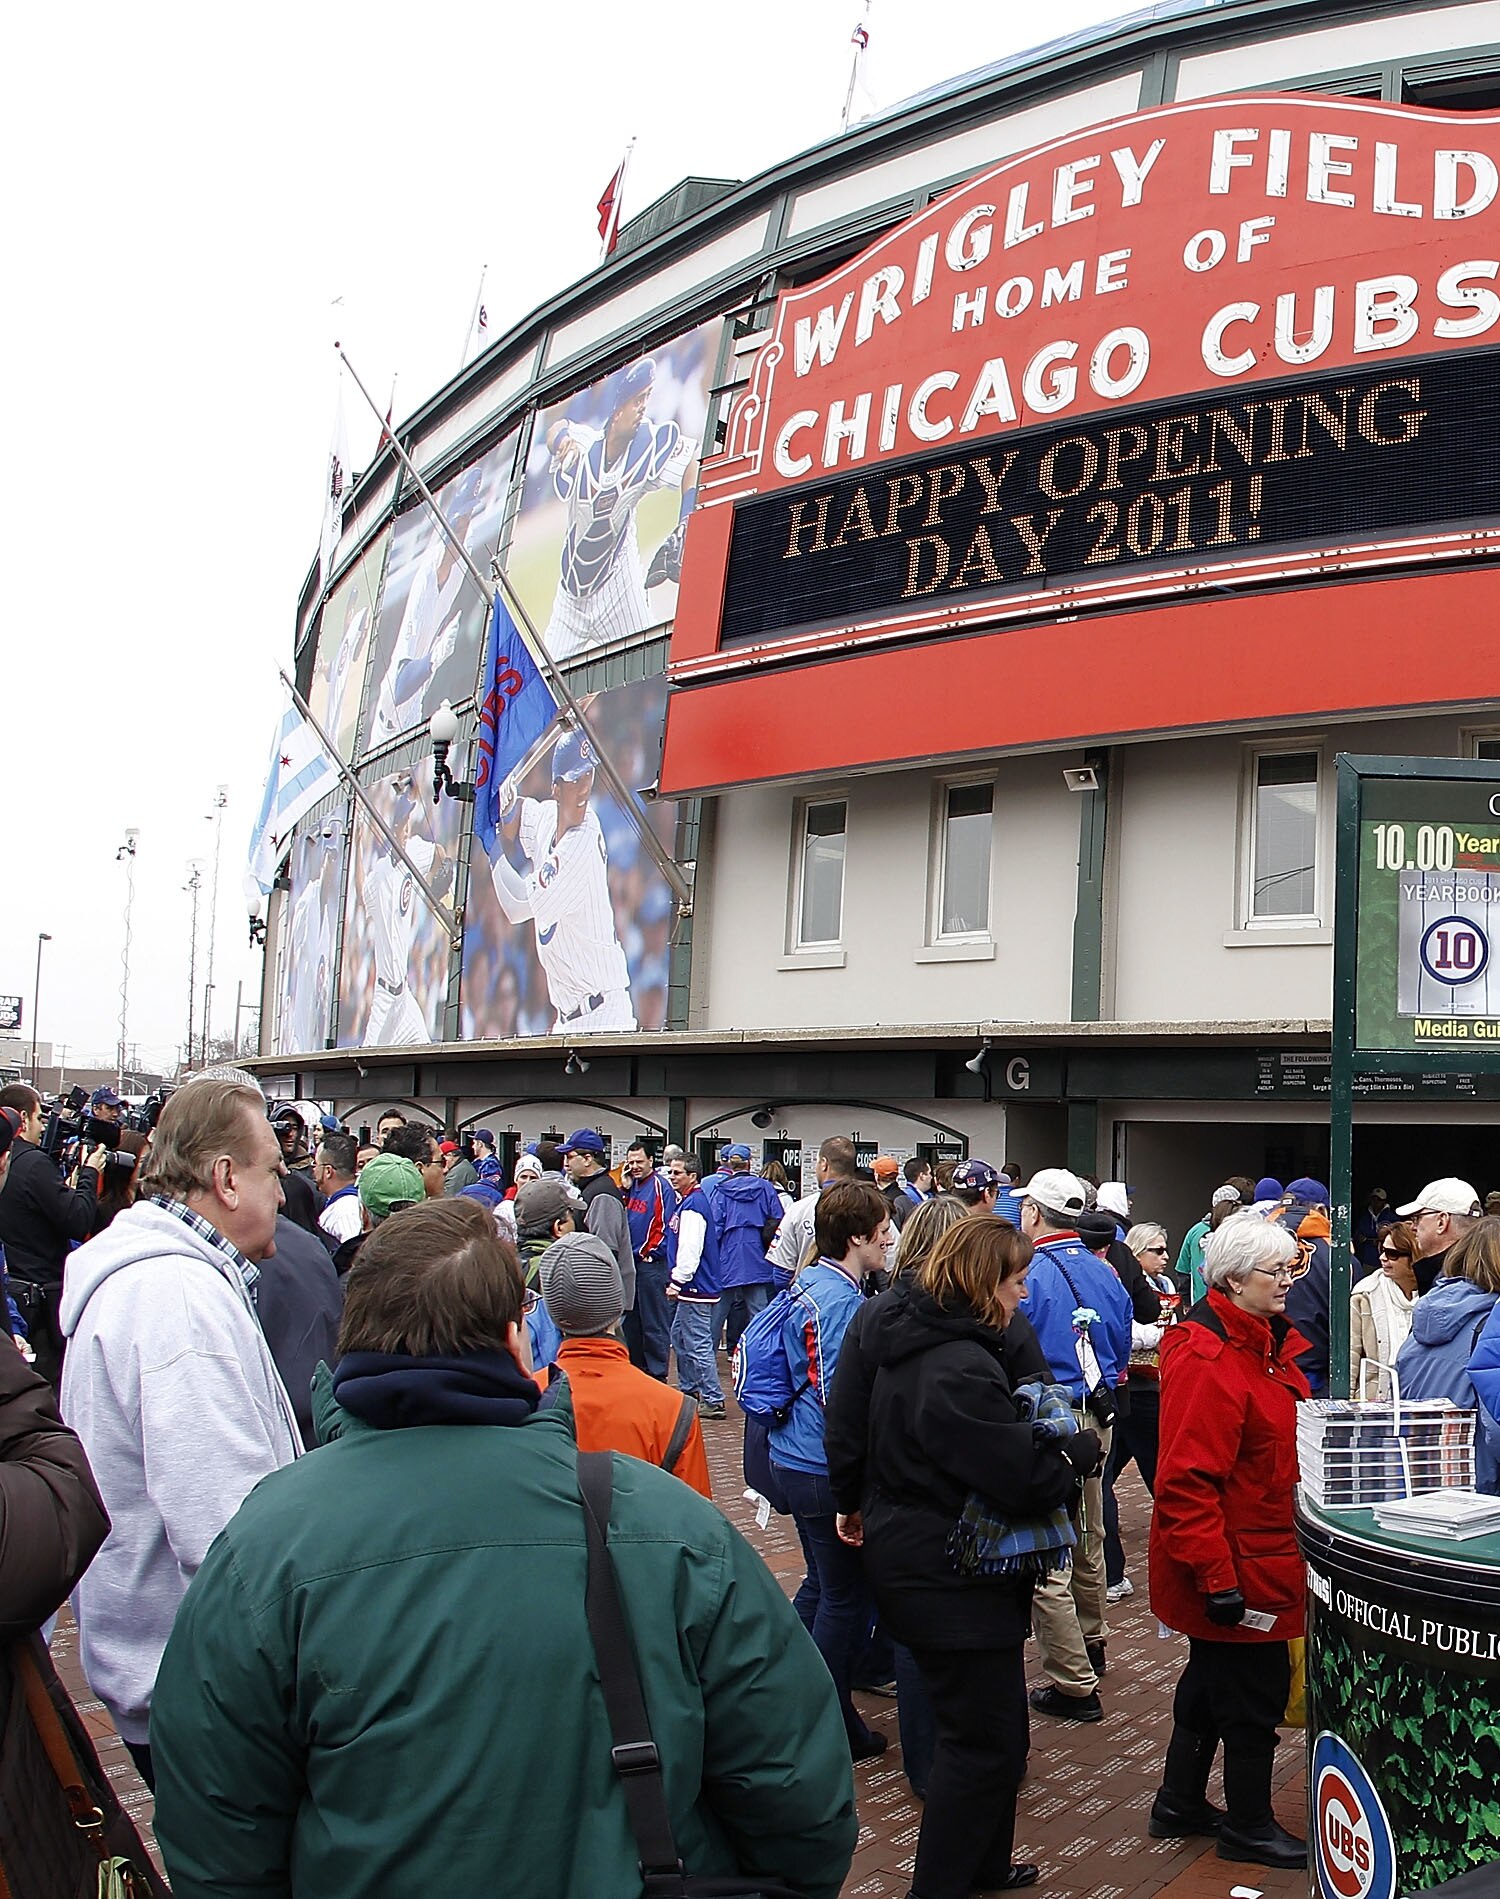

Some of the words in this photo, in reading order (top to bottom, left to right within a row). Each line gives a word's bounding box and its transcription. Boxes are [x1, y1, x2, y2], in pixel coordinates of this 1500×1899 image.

[794, 137, 1167, 378] WRIGLEY
[1208, 127, 1500, 221] FIELD
[952, 248, 1132, 332] HOME
[1183, 214, 1277, 273] OF
[773, 325, 1151, 478] CHICAGO
[1201, 259, 1500, 377] CUBS
[782, 449, 1020, 559] HAPPY
[1037, 377, 1428, 501] OPENING
[900, 508, 1064, 599] DAY
[1083, 473, 1264, 566] 2011!
[1372, 824, 1454, 872] 10.00
[1434, 930, 1477, 970] 10
[1413, 1019, 1468, 1039] Media
[1005, 1056, 1030, 1091] G
[507, 1123, 514, 1131] 17
[709, 1128, 719, 1138] 13
[777, 1129, 788, 1139] 12
[850, 1131, 861, 1142] 11
[933, 1132, 946, 1144] 10
[783, 1149, 800, 1167] OPE
[1336, 1589, 1417, 1643] OFFICIAL
